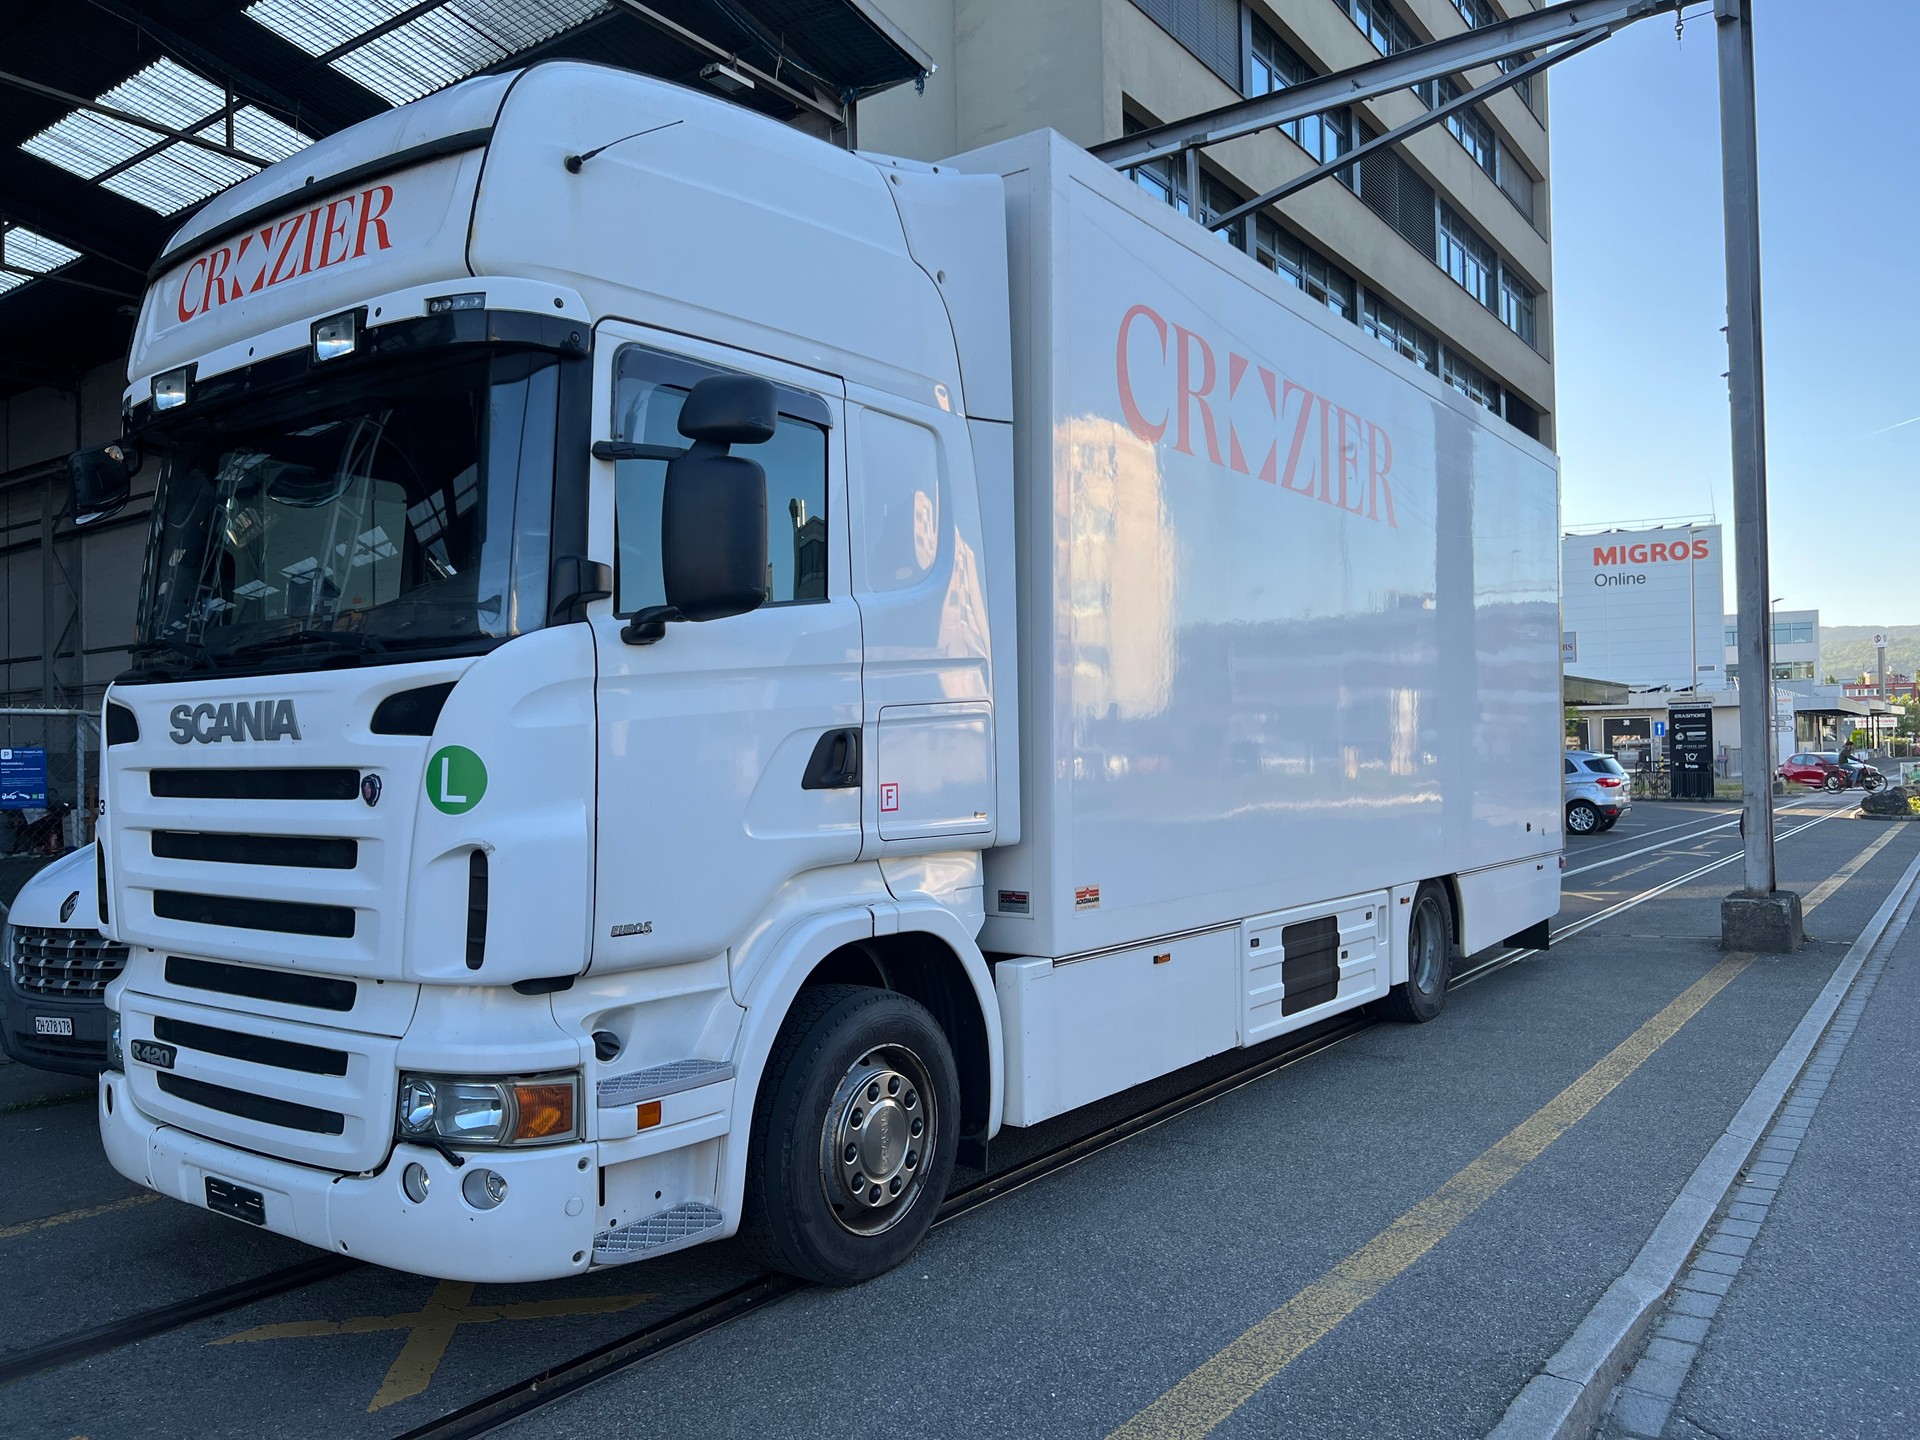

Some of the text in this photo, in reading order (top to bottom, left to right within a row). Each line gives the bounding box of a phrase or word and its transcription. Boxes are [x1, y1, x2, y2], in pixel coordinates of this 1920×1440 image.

[178, 185, 394, 323] CROZIER
[1116, 304, 1398, 529] CROZIER
[1593, 539, 1709, 566] MIGROS
[1594, 572, 1646, 587] Online
[1562, 643, 1573, 651] BS
[169, 699, 302, 745] SCANIA
[441, 757, 466, 803] L
[886, 789, 893, 806] F
